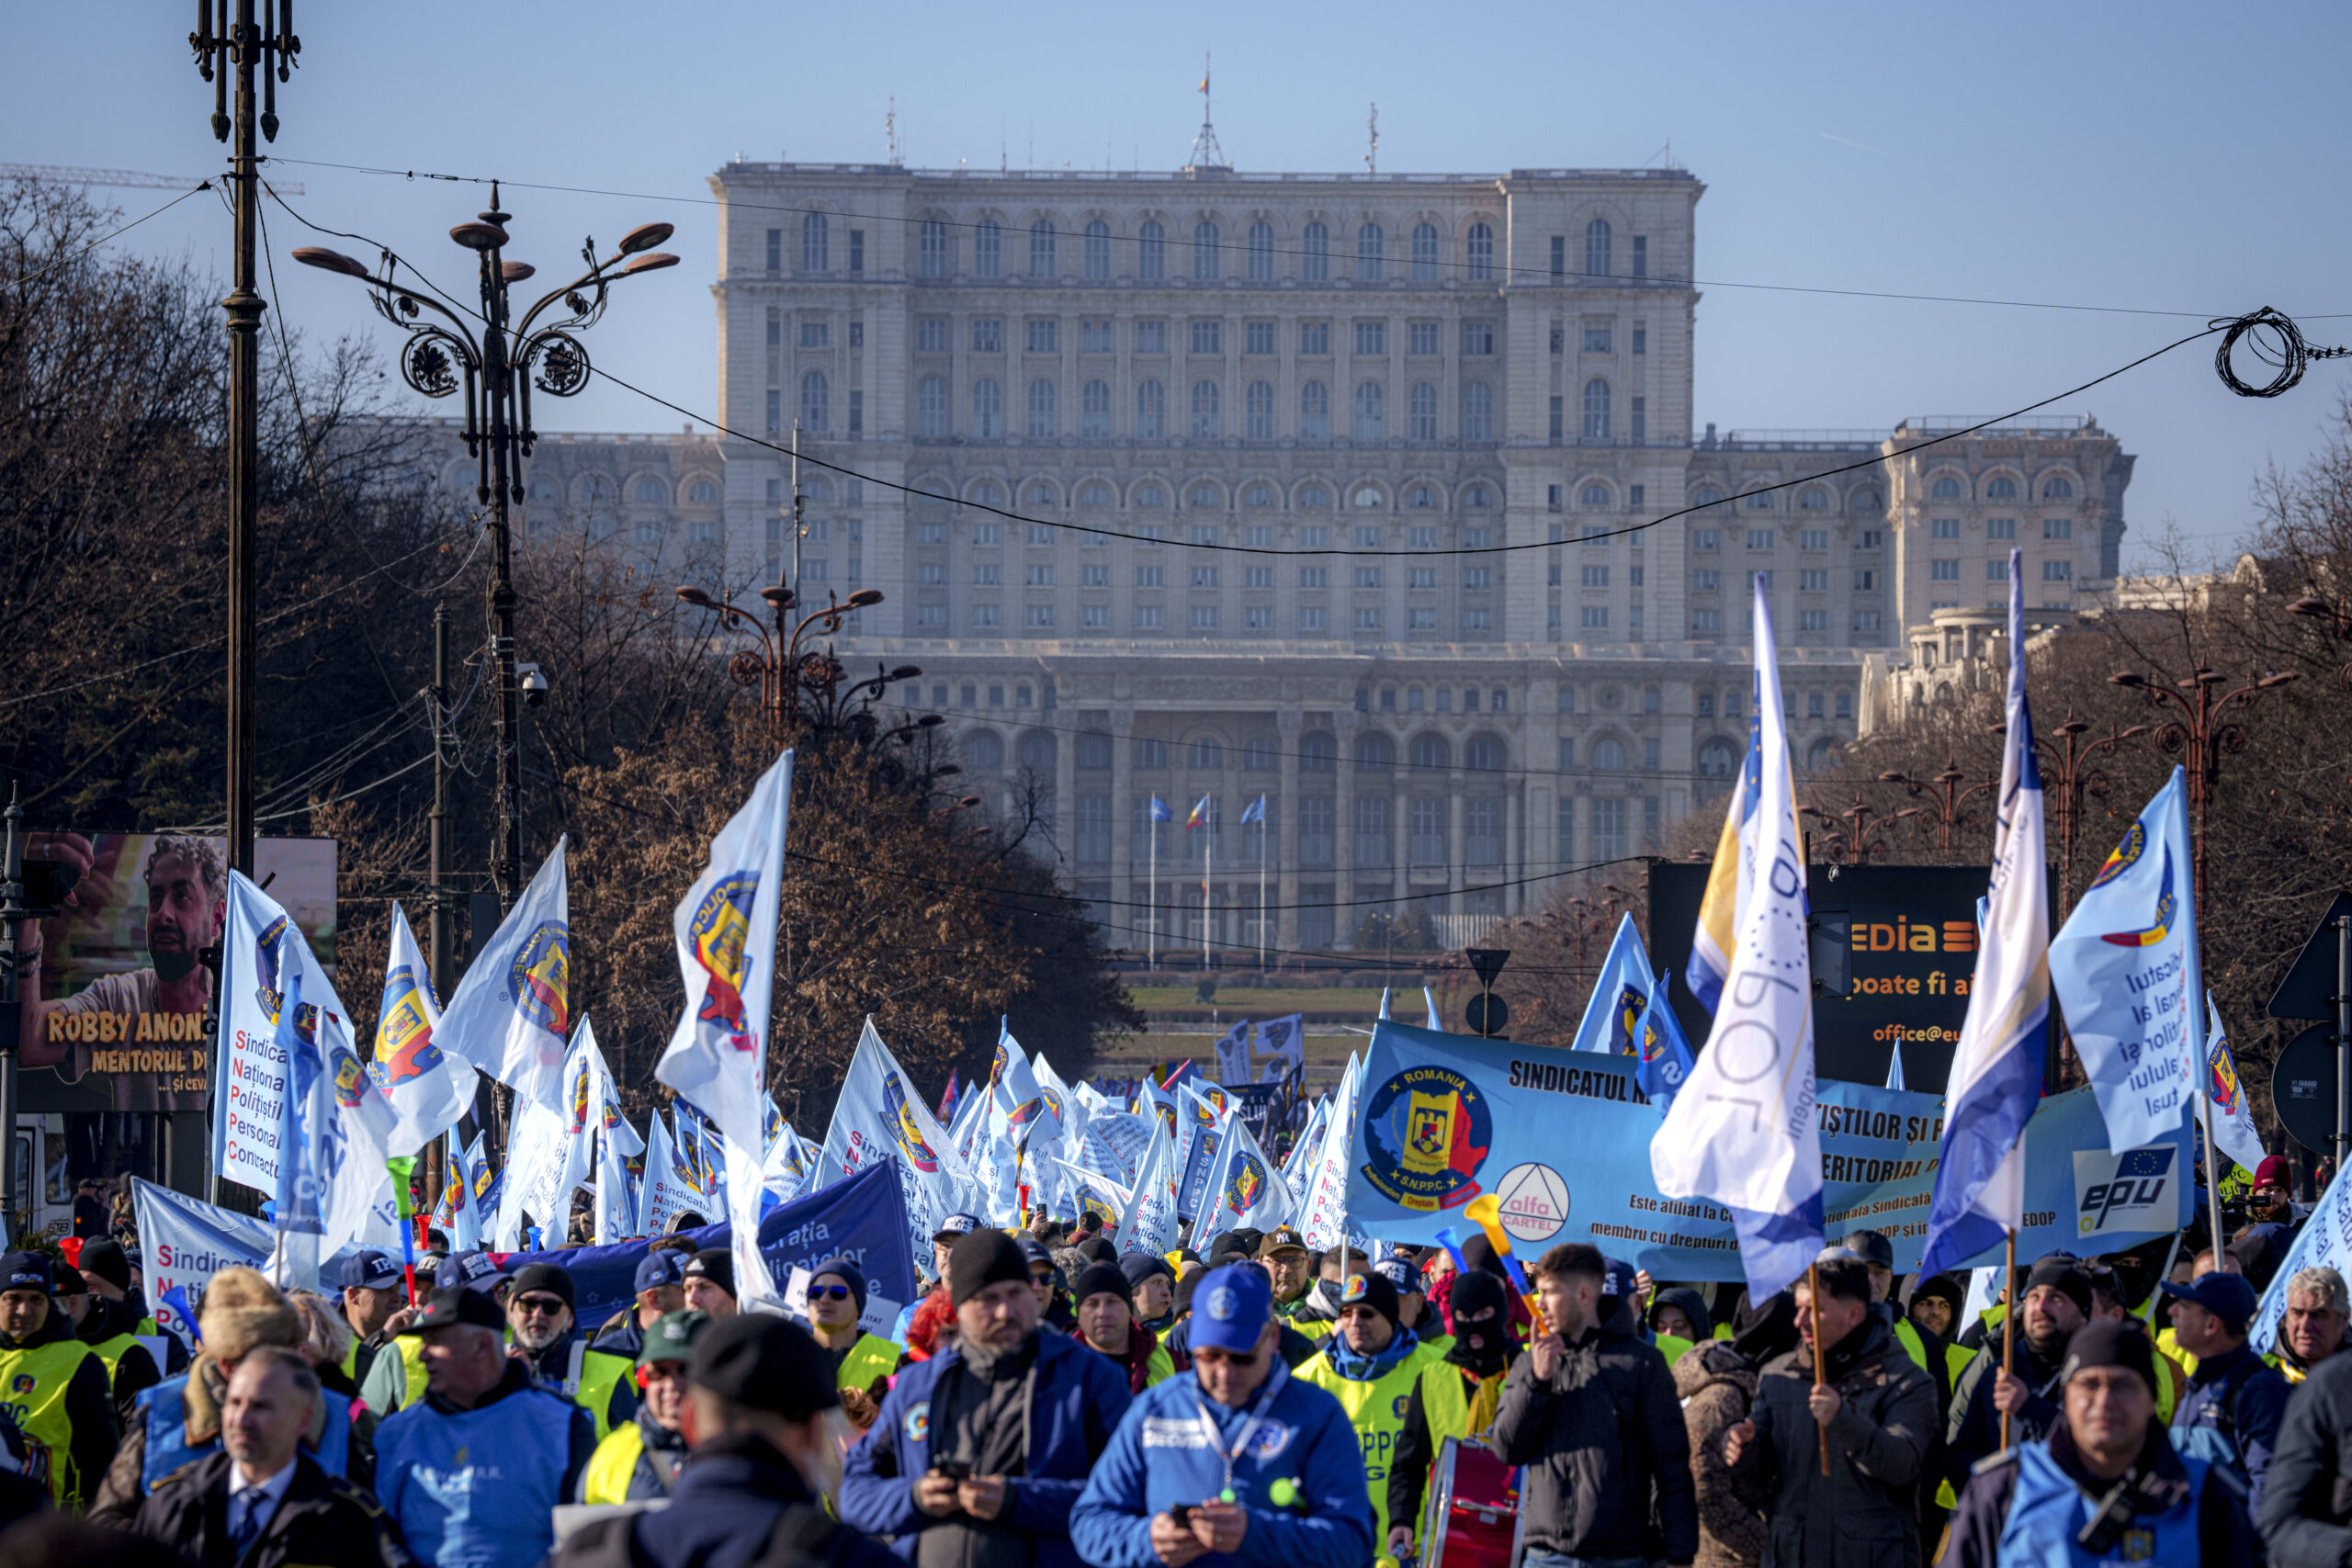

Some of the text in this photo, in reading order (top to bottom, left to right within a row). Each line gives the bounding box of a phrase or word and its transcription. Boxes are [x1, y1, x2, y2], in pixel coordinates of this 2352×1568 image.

[1928, 971, 1946, 995] fi
[48, 1010, 131, 1043] ROBBY
[92, 1050, 187, 1073] MENTORUL
[1403, 1069, 1467, 1092] ROMANIA
[1509, 1059, 1627, 1103] SINDICATUL
[1905, 1115, 1928, 1147] ȘI
[1510, 1195, 1550, 1216] alfa
[1629, 1194, 1657, 1213] Este
[1660, 1200, 1702, 1219] afiliat
[1703, 1205, 1716, 1220] la
[2079, 1178, 2166, 1231] epu
[1501, 1213, 1555, 1233] CARTEL
[1590, 1223, 1647, 1242] membru
[1650, 1231, 1667, 1245] cu
[1670, 1231, 1727, 1250] drepturi
[1903, 1221, 1915, 1240] și
